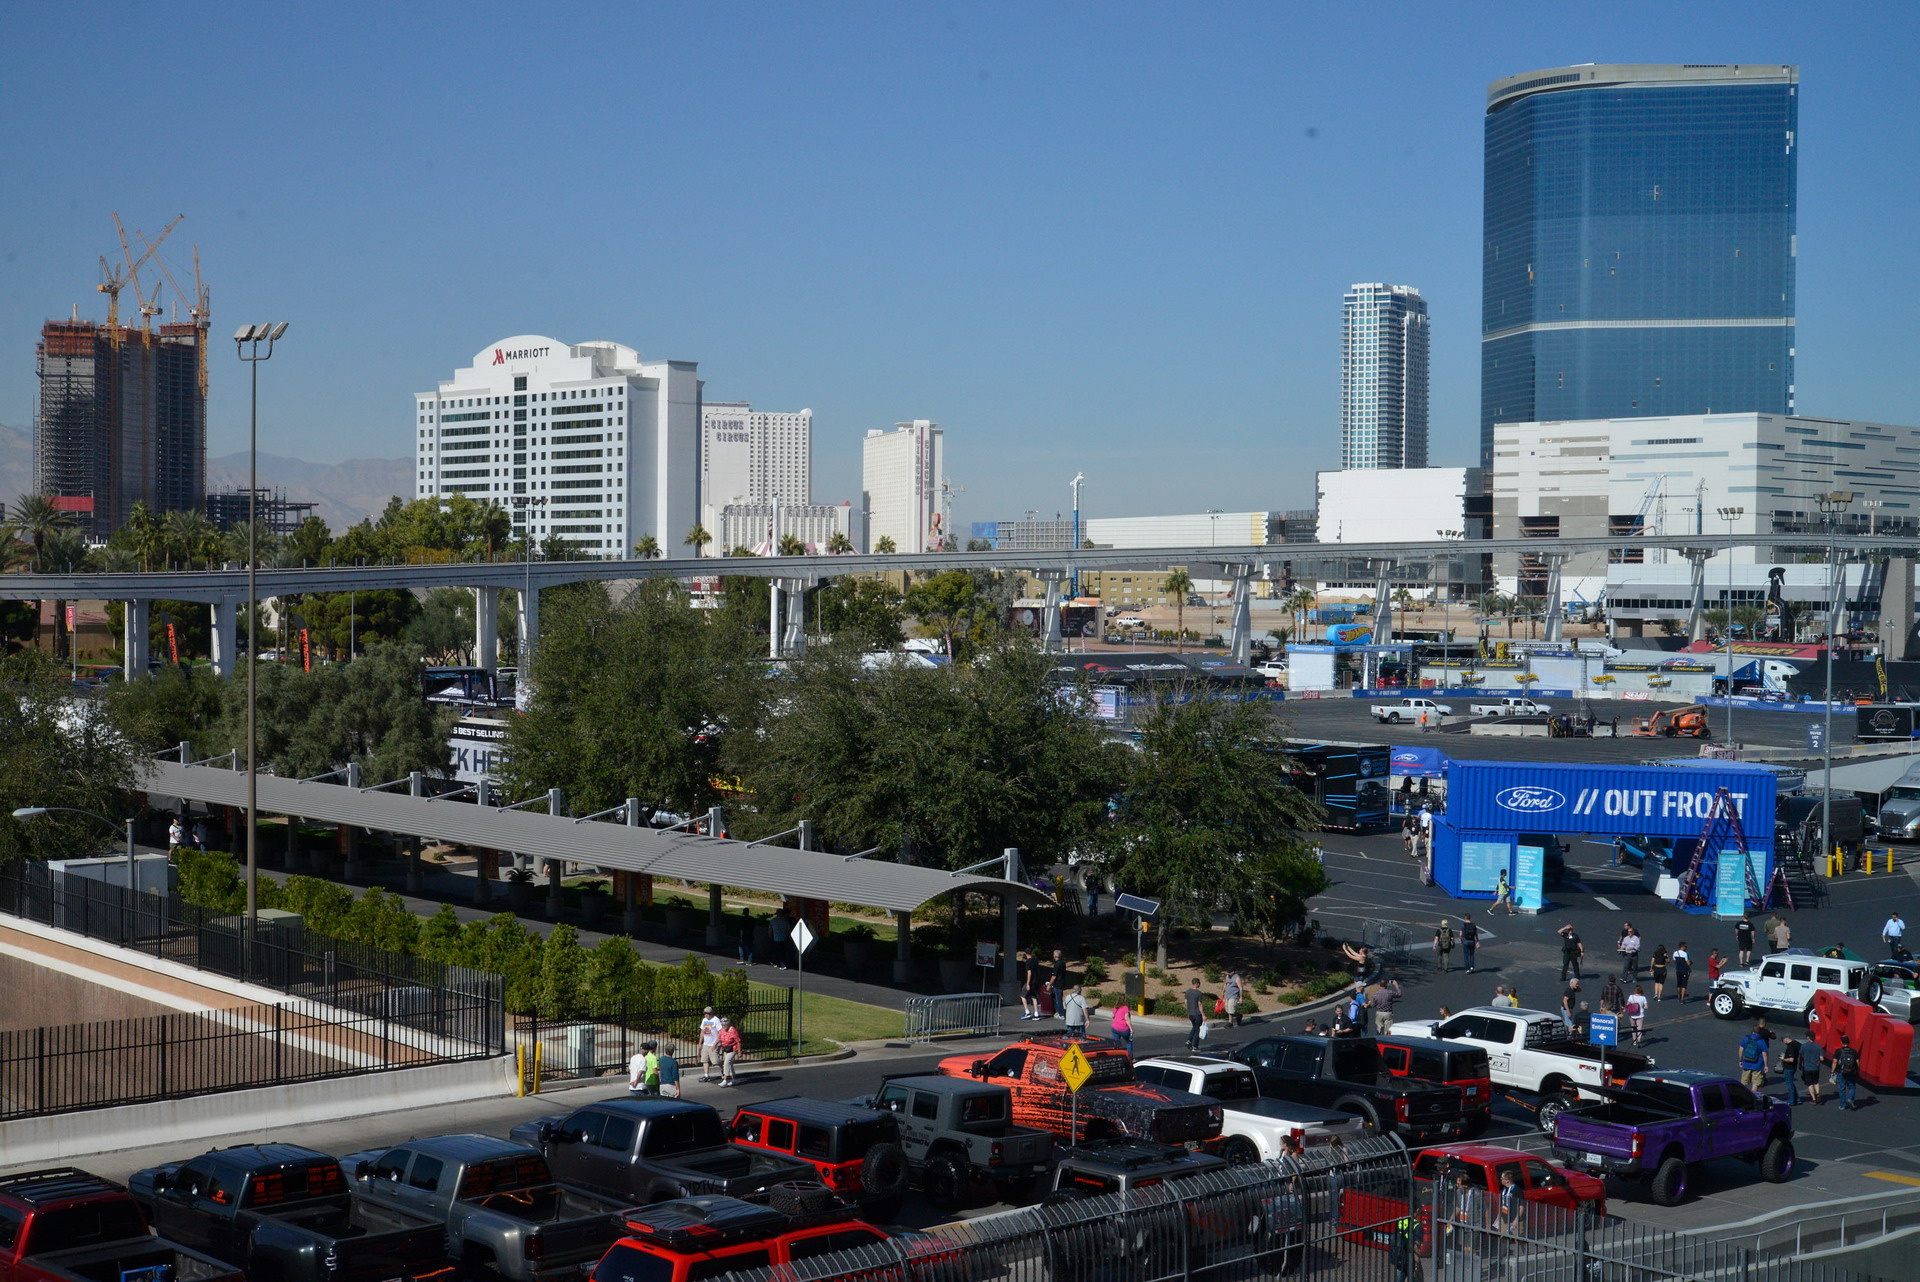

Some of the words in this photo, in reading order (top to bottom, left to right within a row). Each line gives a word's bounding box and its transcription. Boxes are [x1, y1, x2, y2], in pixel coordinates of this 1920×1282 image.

[505, 347, 550, 360] MARRIOTT
[711, 419, 744, 430] CIRCUS
[716, 432, 749, 442] CIRCUS
[458, 727, 475, 736] BEST
[476, 730, 504, 738] SELLING
[1813, 740, 1819, 748] 2
[1716, 752, 1734, 760] SEMA
[1505, 788, 1555, 810] Ford
[1604, 789, 1657, 816] OUT
[1662, 790, 1749, 819] FRONT
[1810, 989, 1914, 1087] SEMA
